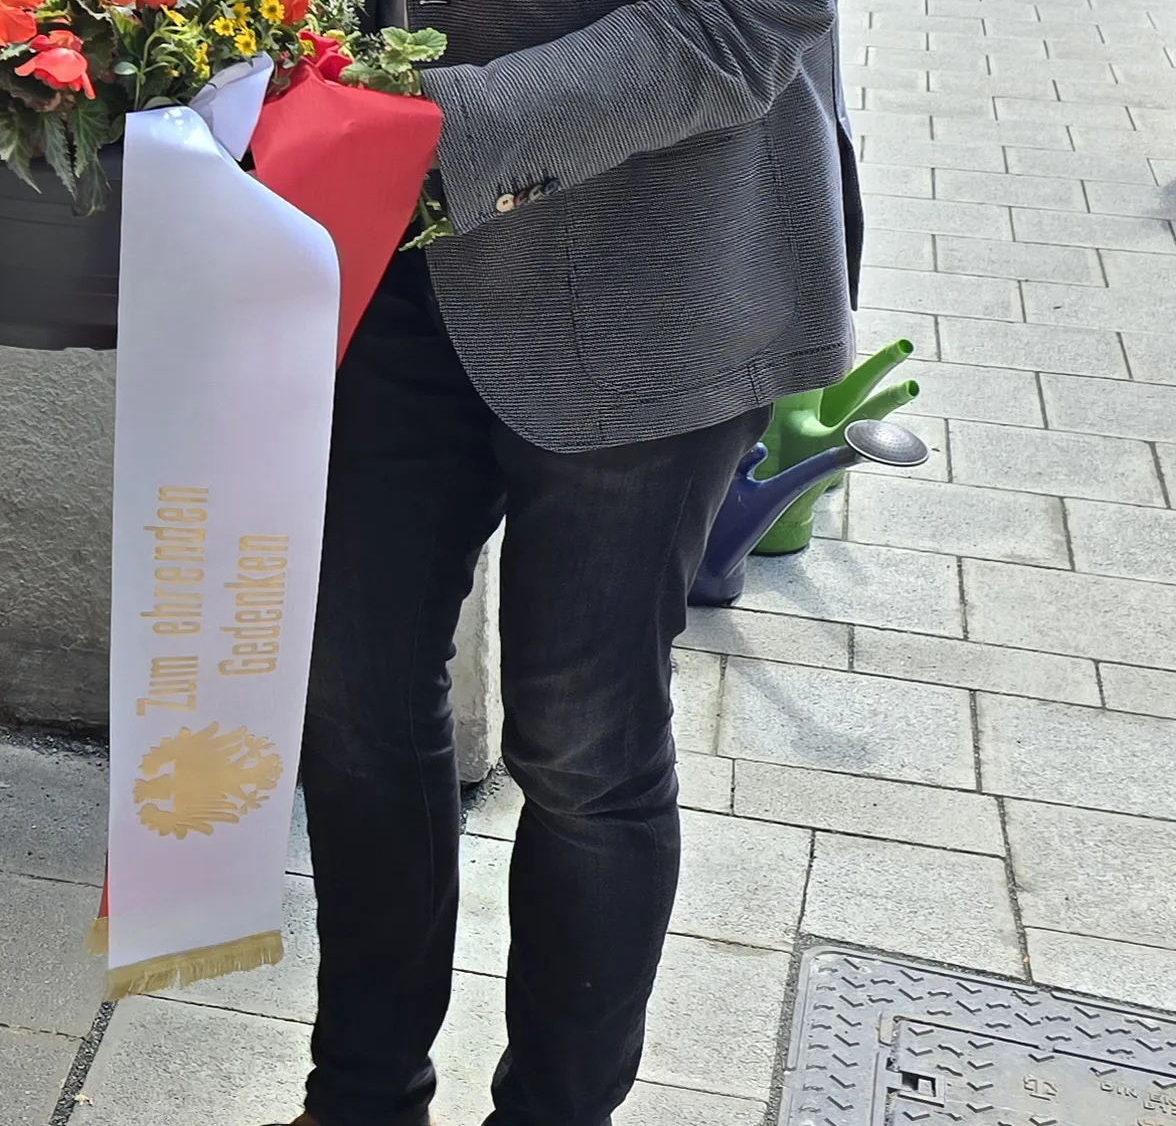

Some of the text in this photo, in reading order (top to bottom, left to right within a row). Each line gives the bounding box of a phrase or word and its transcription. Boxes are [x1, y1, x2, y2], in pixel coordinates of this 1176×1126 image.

[136, 485, 209, 716] Zum ehrenden
[218, 534, 290, 676] Gedenken
